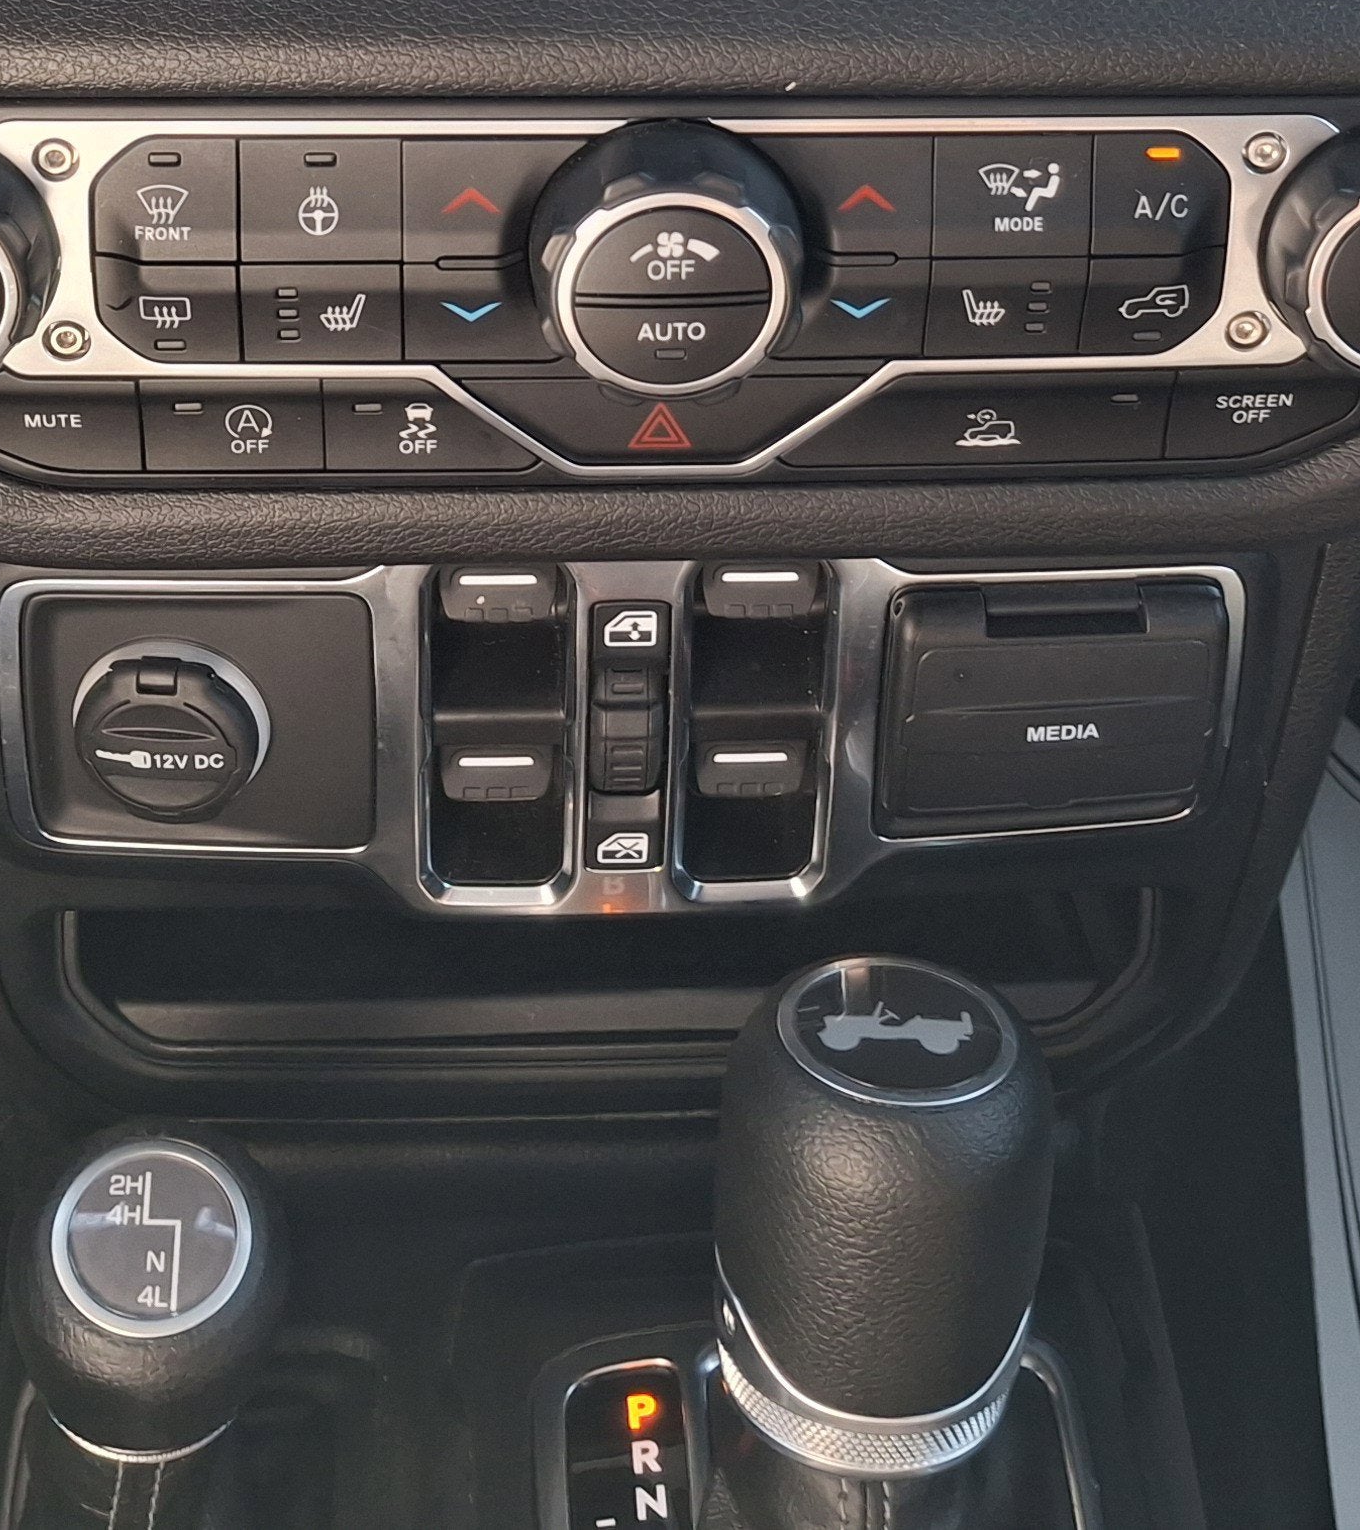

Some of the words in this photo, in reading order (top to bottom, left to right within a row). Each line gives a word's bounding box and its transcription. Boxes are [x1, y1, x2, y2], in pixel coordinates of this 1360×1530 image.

[1133, 193, 1189, 221] A/C
[133, 225, 191, 242] FRONT
[993, 216, 1044, 233] MODE
[646, 259, 696, 282] OFF
[637, 321, 707, 342] AUTO
[1214, 393, 1294, 411] SCREEN
[23, 413, 83, 430] MUTE
[1231, 408, 1271, 425] OFF
[230, 438, 270, 455] OFF
[398, 438, 438, 456] OFF
[1026, 722, 1100, 743] MEDIA
[152, 753, 189, 770] 12V
[194, 752, 225, 770] DC
[108, 1174, 144, 1196] 2H
[105, 1203, 142, 1226] 4H
[145, 1250, 166, 1273] N
[136, 1285, 169, 1308] 4L
[625, 1393, 658, 1431] P
[630, 1439, 663, 1476] R
[634, 1482, 669, 1522] N
